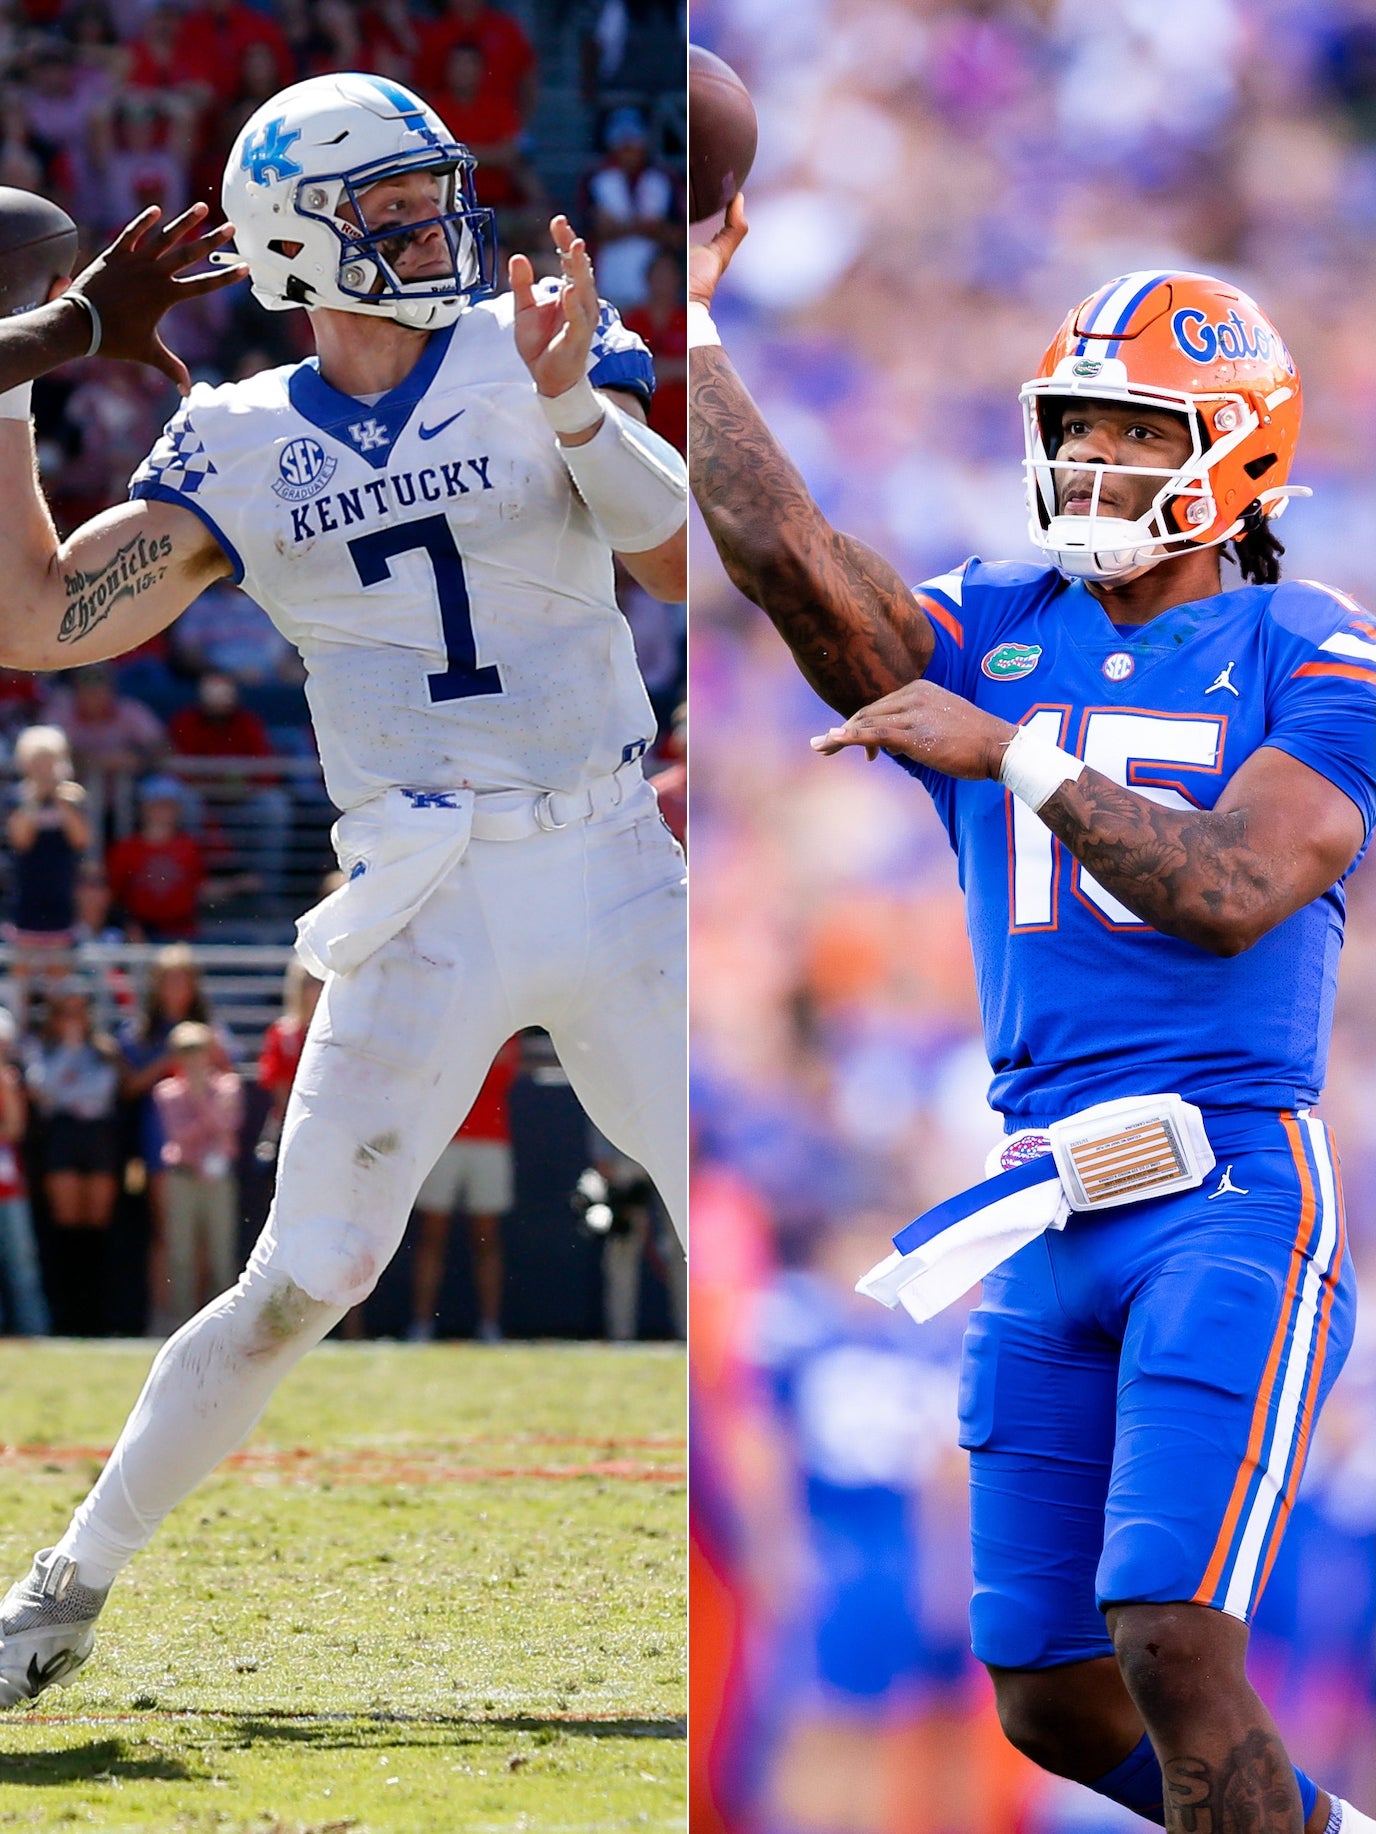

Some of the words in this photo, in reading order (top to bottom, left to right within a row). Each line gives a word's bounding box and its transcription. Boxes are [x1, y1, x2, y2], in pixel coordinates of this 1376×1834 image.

[280, 438, 324, 486] SEC
[348, 418, 390, 452] UK
[281, 464, 334, 500] GRADUATE
[291, 456, 495, 543] KENTUCKY
[57, 534, 172, 642] Chronicles
[346, 512, 504, 703] 7
[1104, 653, 1134, 682] SEC
[1009, 703, 1229, 934] 15
